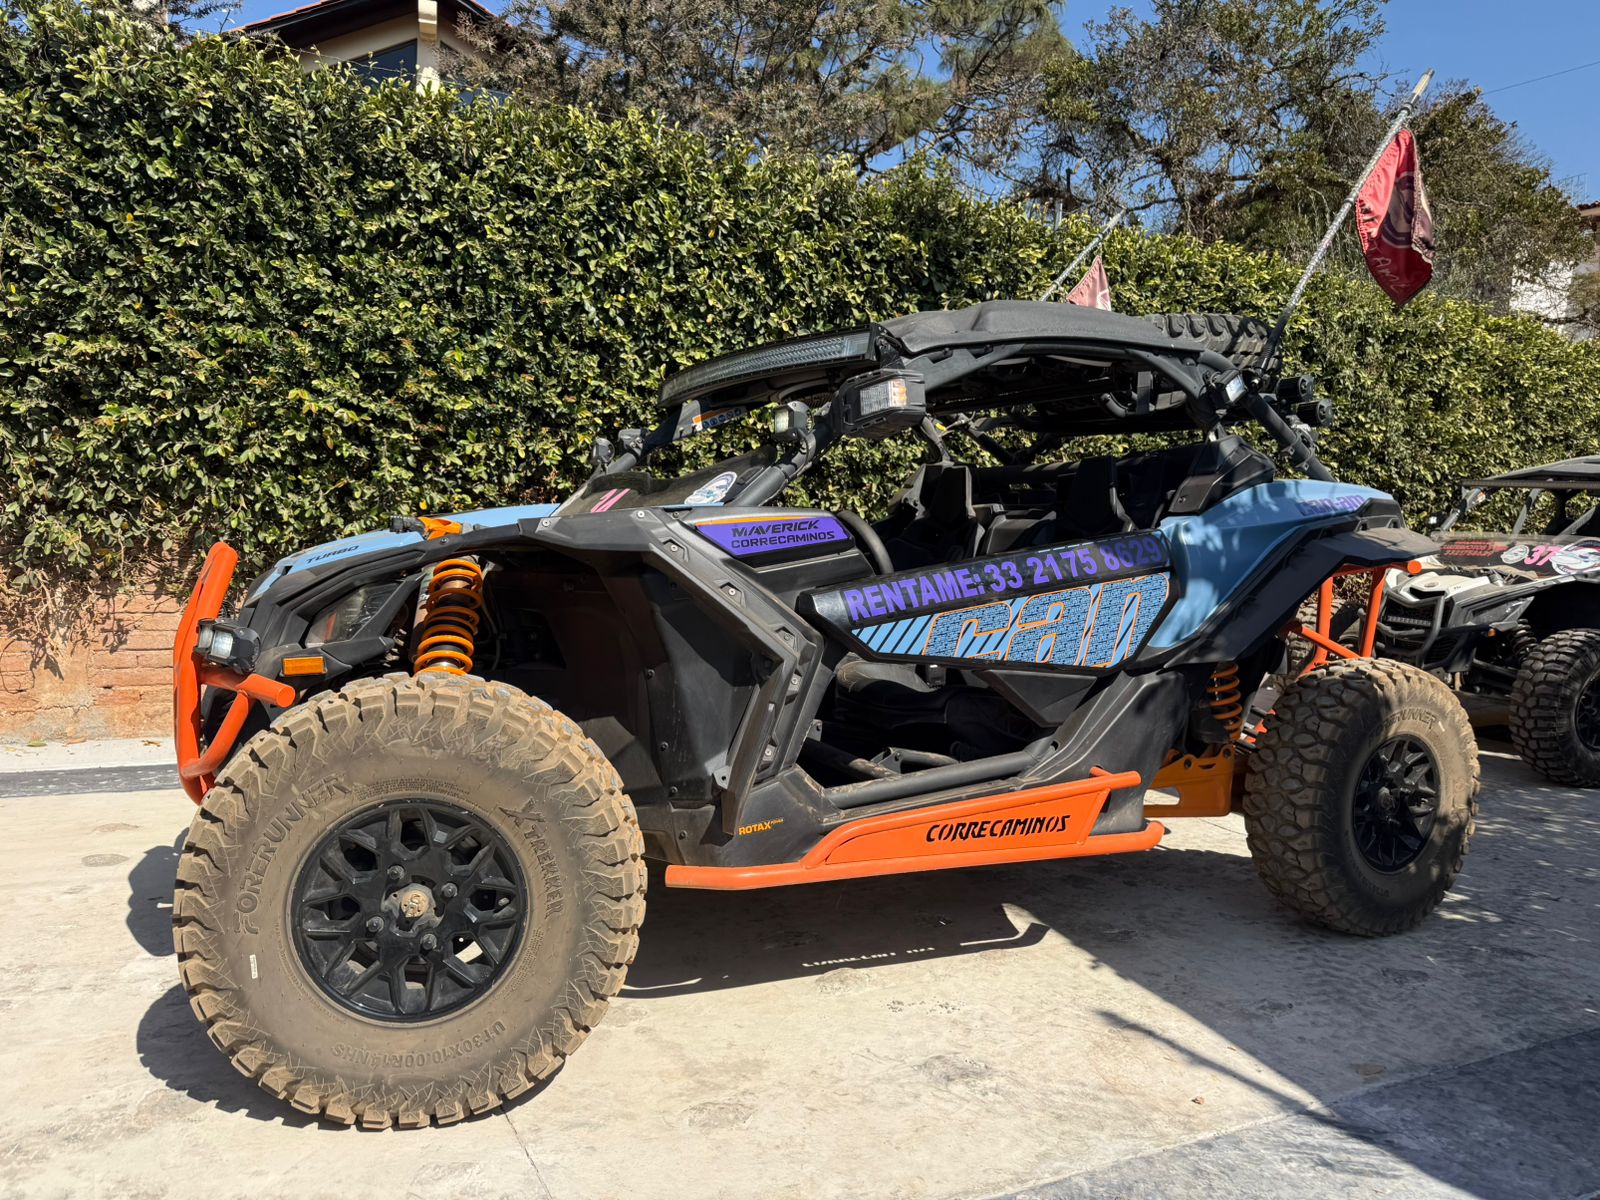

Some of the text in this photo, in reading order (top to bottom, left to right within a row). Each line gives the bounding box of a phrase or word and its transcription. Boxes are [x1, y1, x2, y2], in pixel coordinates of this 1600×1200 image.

[731, 519, 820, 538] MAVERICK
[731, 530, 836, 549] CORRECAMINOS
[305, 545, 360, 564] TURBO
[1523, 544, 1565, 566] 37
[843, 568, 986, 621] RENTAME:
[984, 560, 1024, 593] 33
[1099, 536, 1163, 571] 8629
[738, 821, 772, 836] ROTAX
[926, 814, 1071, 843] CORRECAMINOS
[233, 773, 351, 936] FORERUNNER
